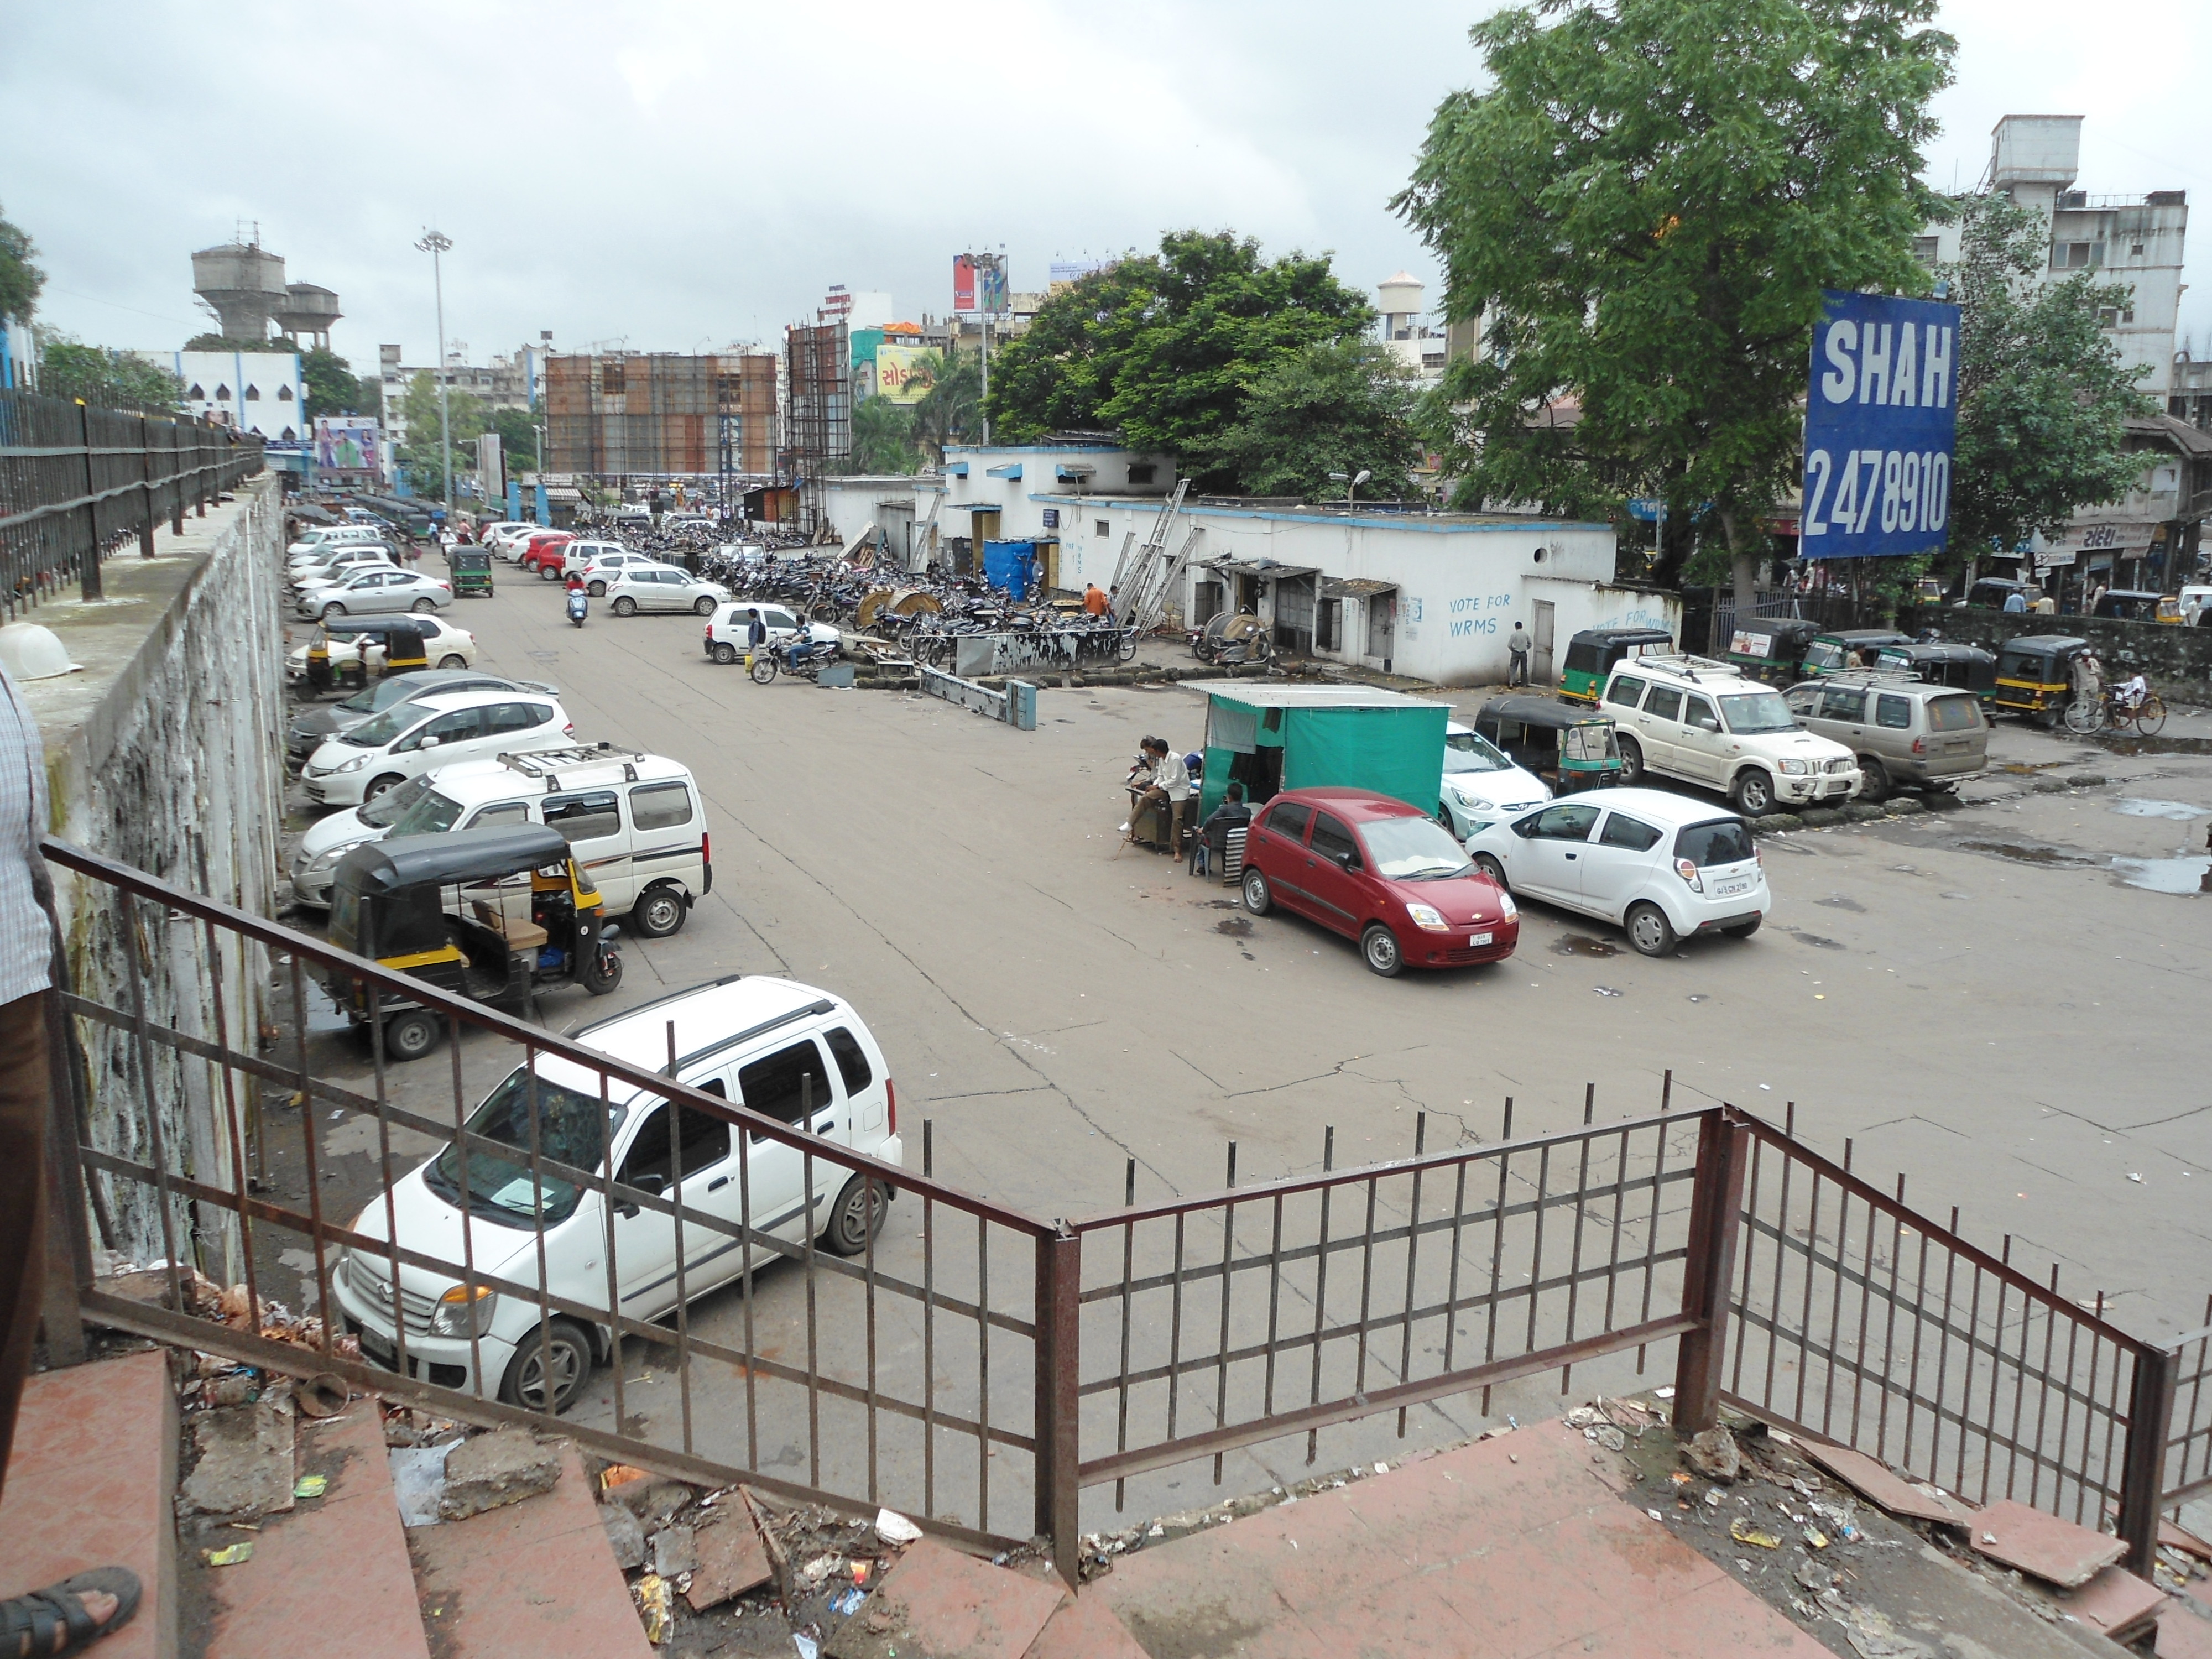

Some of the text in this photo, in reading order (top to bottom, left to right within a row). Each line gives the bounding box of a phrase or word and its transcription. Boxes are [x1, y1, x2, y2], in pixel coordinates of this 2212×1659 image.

[1821, 320, 1952, 408] SHAH
[1805, 449, 1949, 536] 2478910
[1640, 502, 1668, 513] TAA
[1450, 594, 1510, 613] VOTE FOR
[1626, 609, 1646, 625] FOR
[1450, 618, 1497, 637] WRMS
